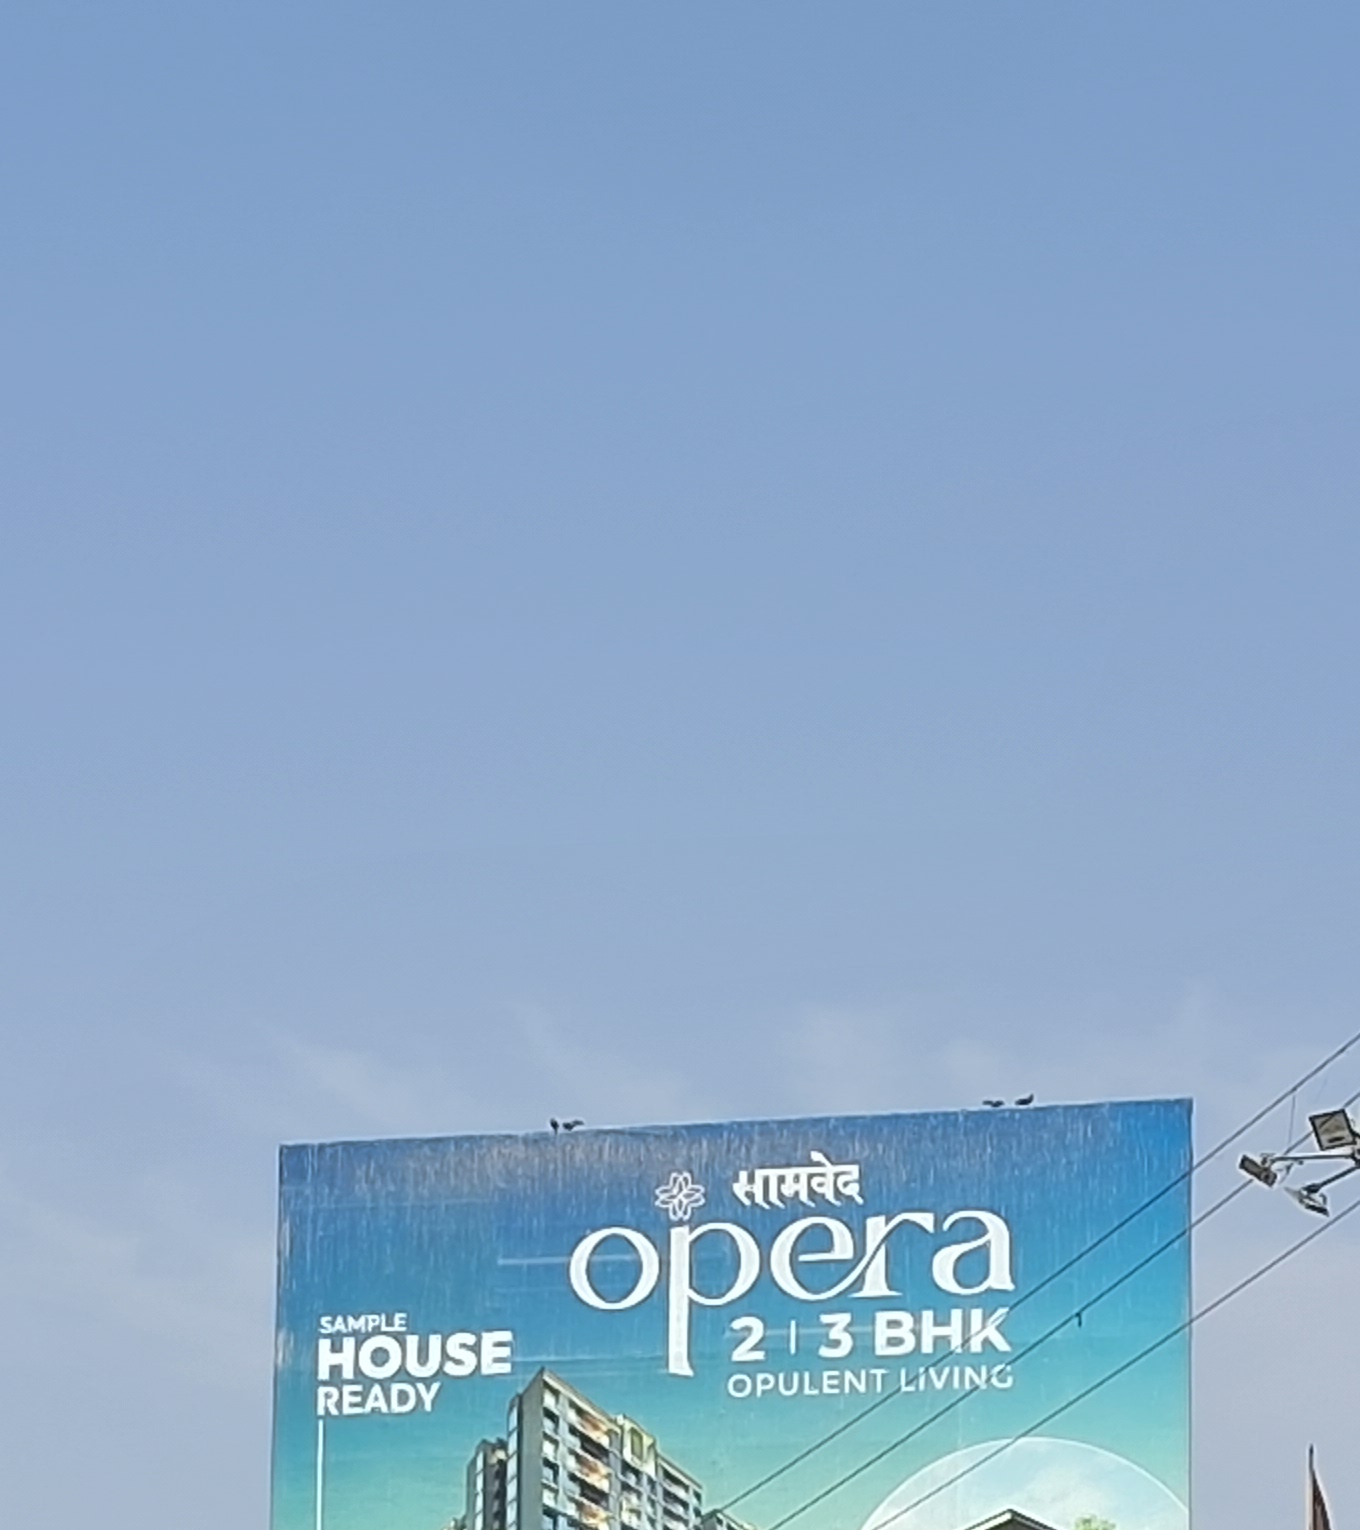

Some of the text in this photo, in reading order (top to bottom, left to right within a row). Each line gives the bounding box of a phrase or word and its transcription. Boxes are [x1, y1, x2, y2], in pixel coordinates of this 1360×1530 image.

[733, 1151, 863, 1208] सामवेद
[569, 1210, 1015, 1377] opera
[319, 1313, 407, 1334] SAMPLE
[730, 1316, 765, 1362] 2
[819, 1313, 853, 1359] 3
[875, 1307, 1011, 1357] BHK
[317, 1331, 513, 1380] HOUSE
[317, 1382, 441, 1416] READY
[728, 1364, 1014, 1398] OPULENT LIVING
